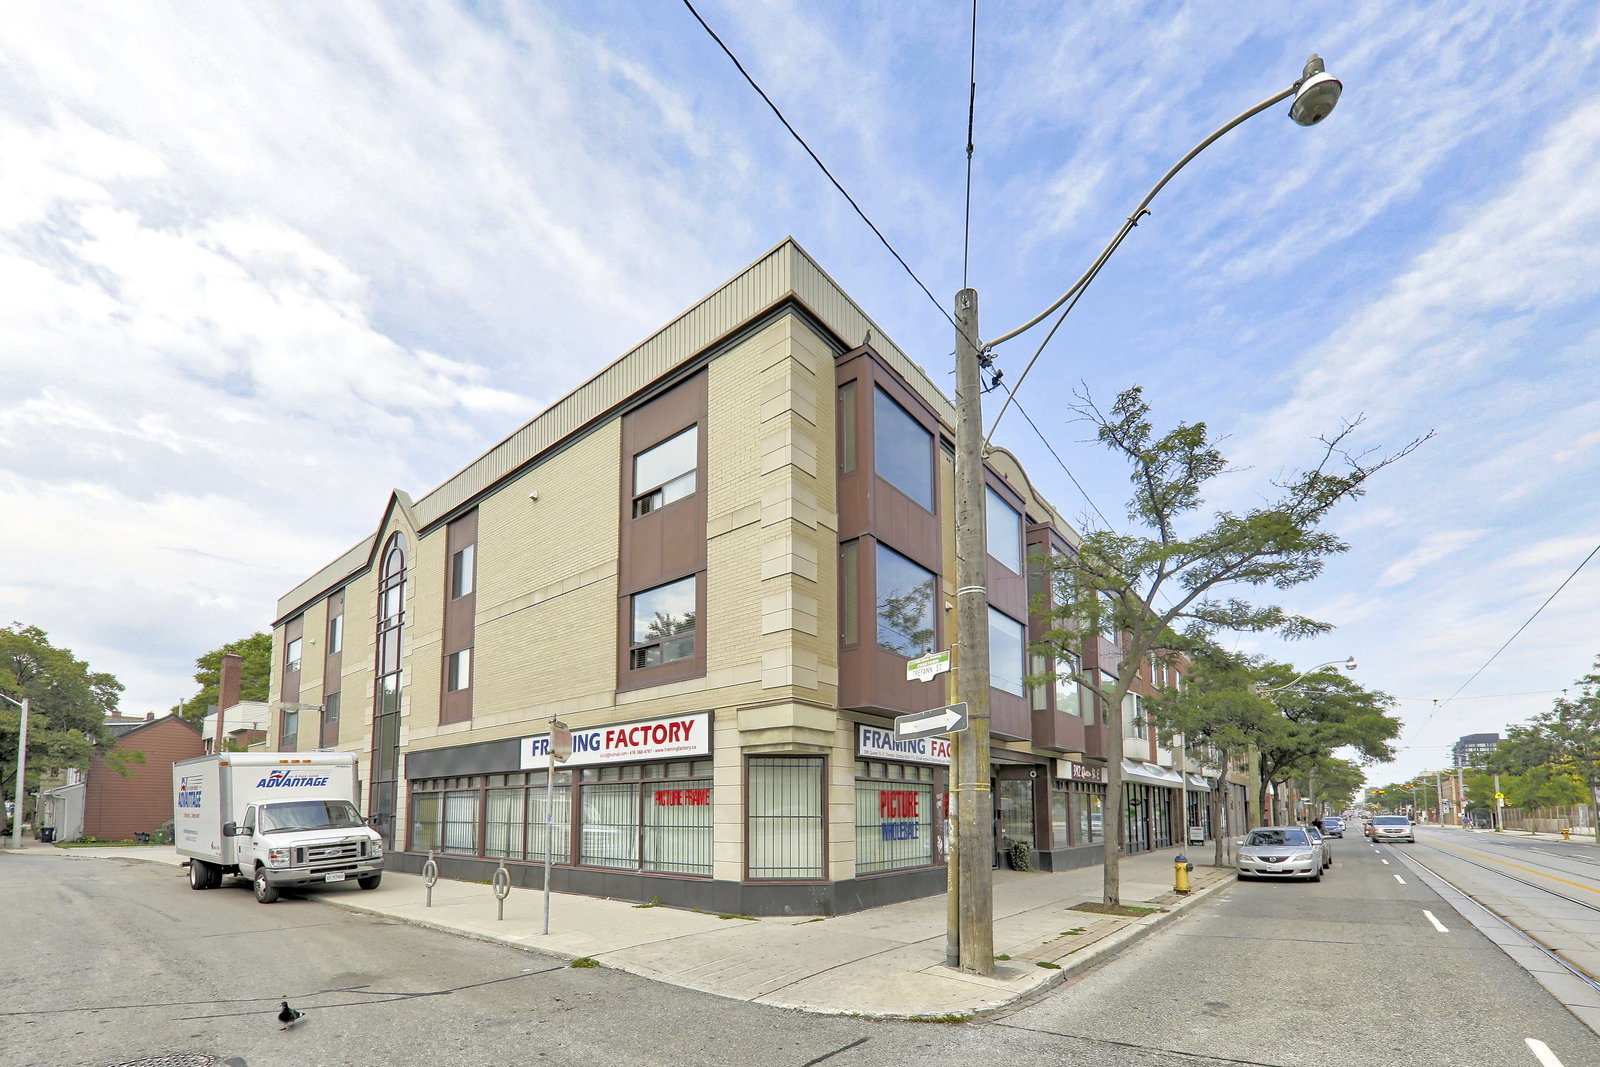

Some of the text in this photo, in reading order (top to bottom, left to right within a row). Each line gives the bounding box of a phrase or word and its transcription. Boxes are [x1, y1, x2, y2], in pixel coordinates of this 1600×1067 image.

[936, 663, 942, 672] ST
[532, 720, 695, 757] FRING FACTORY
[863, 729, 926, 754] FRAMING
[256, 770, 329, 788] ADVANTAGE
[655, 789, 710, 806] PICTURE FRAME
[880, 790, 919, 818] PICTURE
